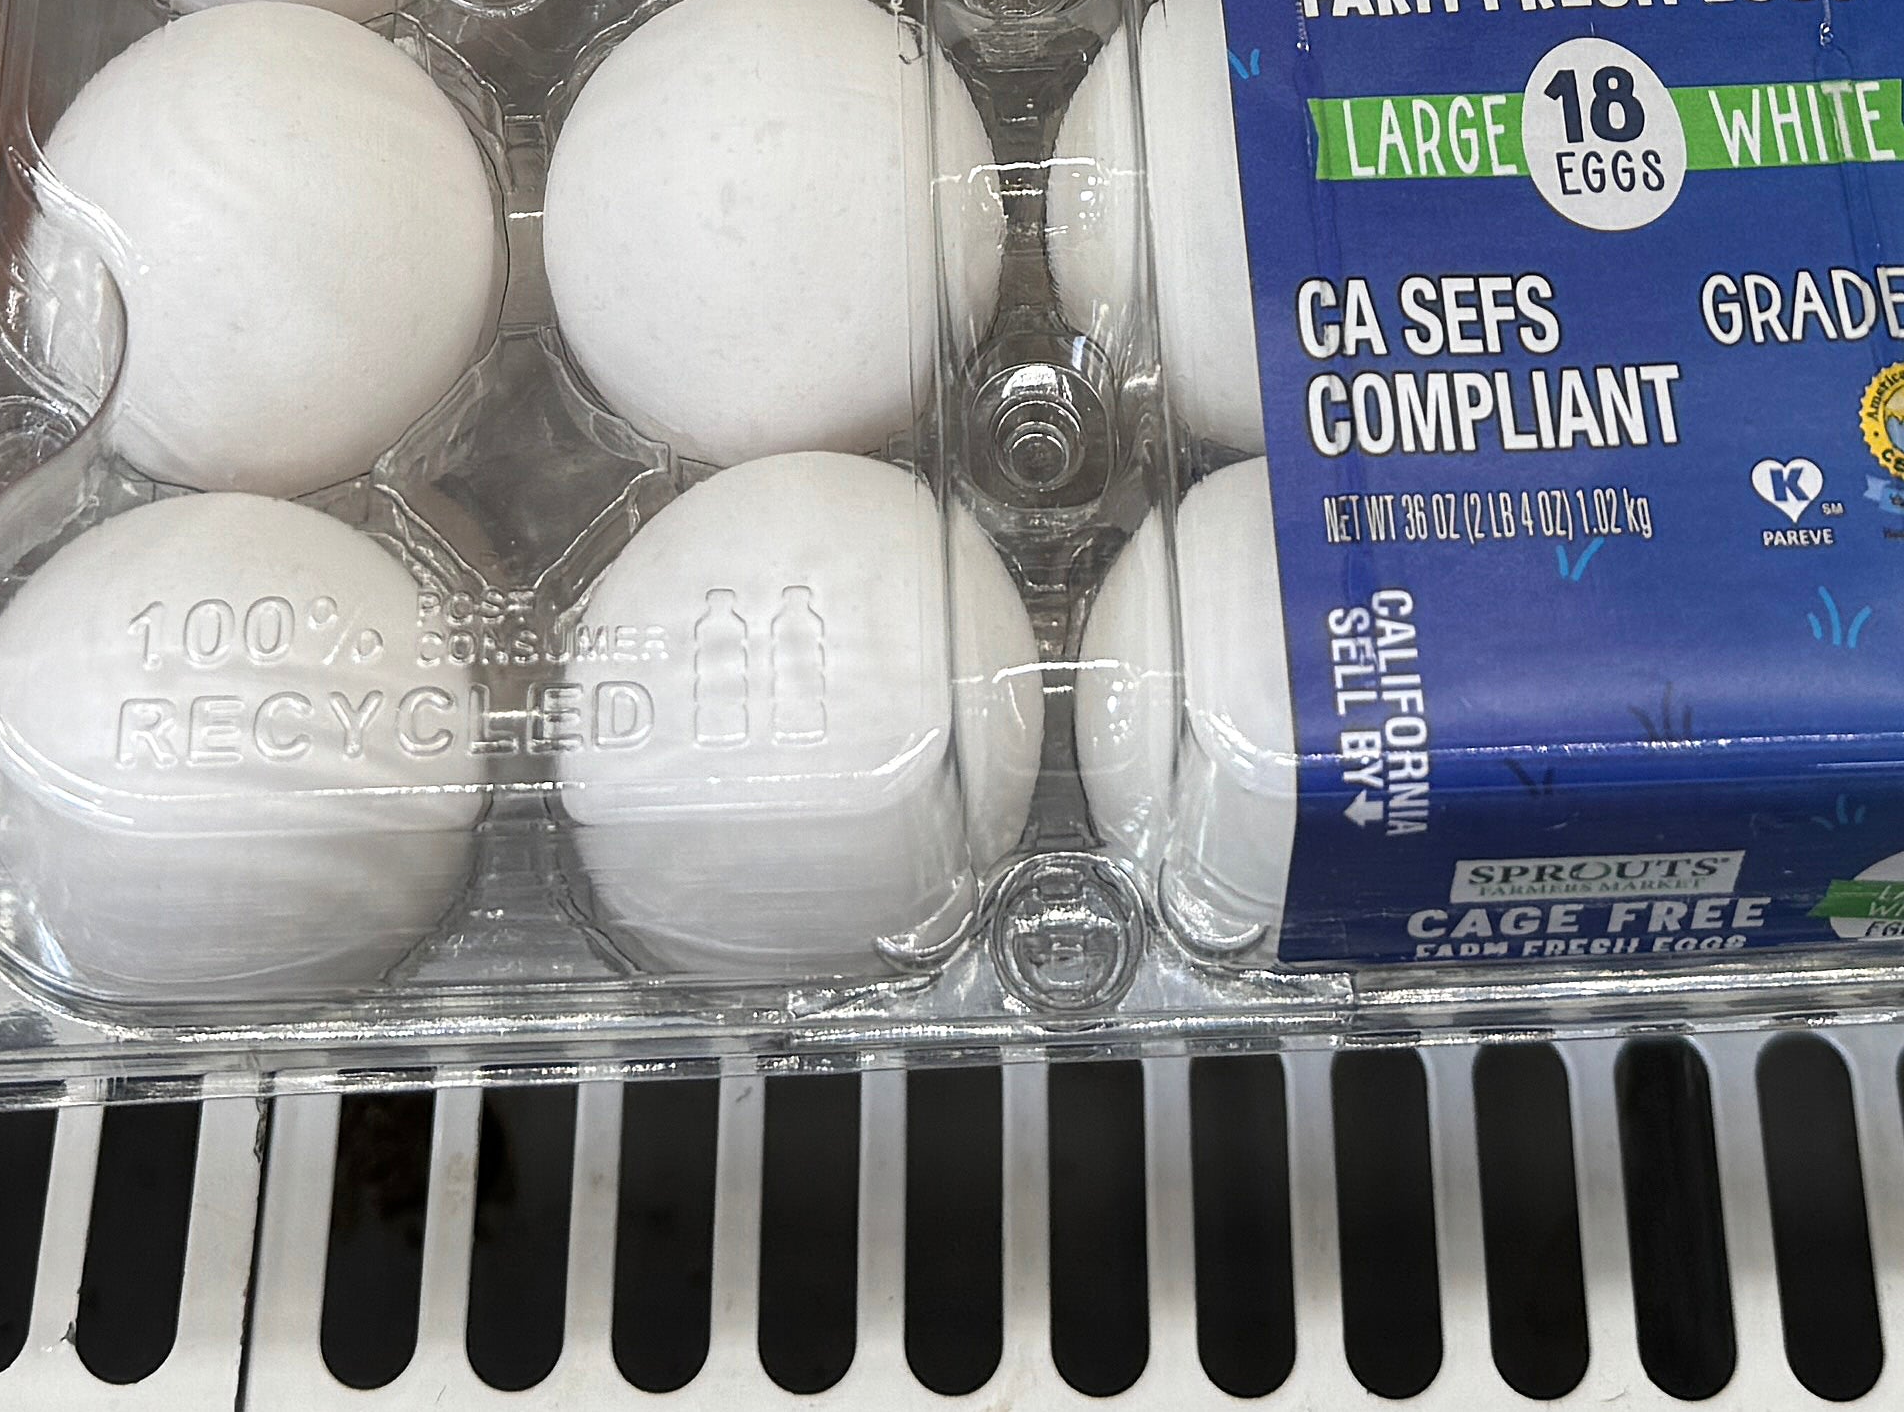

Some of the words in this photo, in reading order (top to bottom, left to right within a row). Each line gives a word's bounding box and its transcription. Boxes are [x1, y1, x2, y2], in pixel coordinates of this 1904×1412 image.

[1340, 95, 1518, 179] LARGE
[1544, 67, 1647, 144] 18
[1708, 81, 1896, 163] WHITE
[1556, 151, 1666, 197] EGGS
[1298, 277, 1387, 356] CA
[1402, 274, 1560, 354] SEFS
[1307, 365, 1683, 456] COMPLIANT
[1324, 495, 1360, 542] NET
[1364, 495, 1395, 540] WT
[1402, 494, 1427, 539] 36
[1432, 493, 1460, 539] OZ
[1464, 492, 1485, 544] (2
[1488, 492, 1516, 538] LB
[1521, 492, 1533, 535] 4
[1538, 490, 1573, 540] OZ)
[1576, 488, 1621, 534] 1.02
[1623, 488, 1652, 538] kg
[1763, 528, 1834, 547] PAREVE
[128, 595, 384, 671] 100%
[1328, 606, 1378, 716] SELL
[116, 682, 654, 770] RECYCLED
[1372, 589, 1429, 836] CALIFORNIA
[1340, 731, 1384, 789] BY
